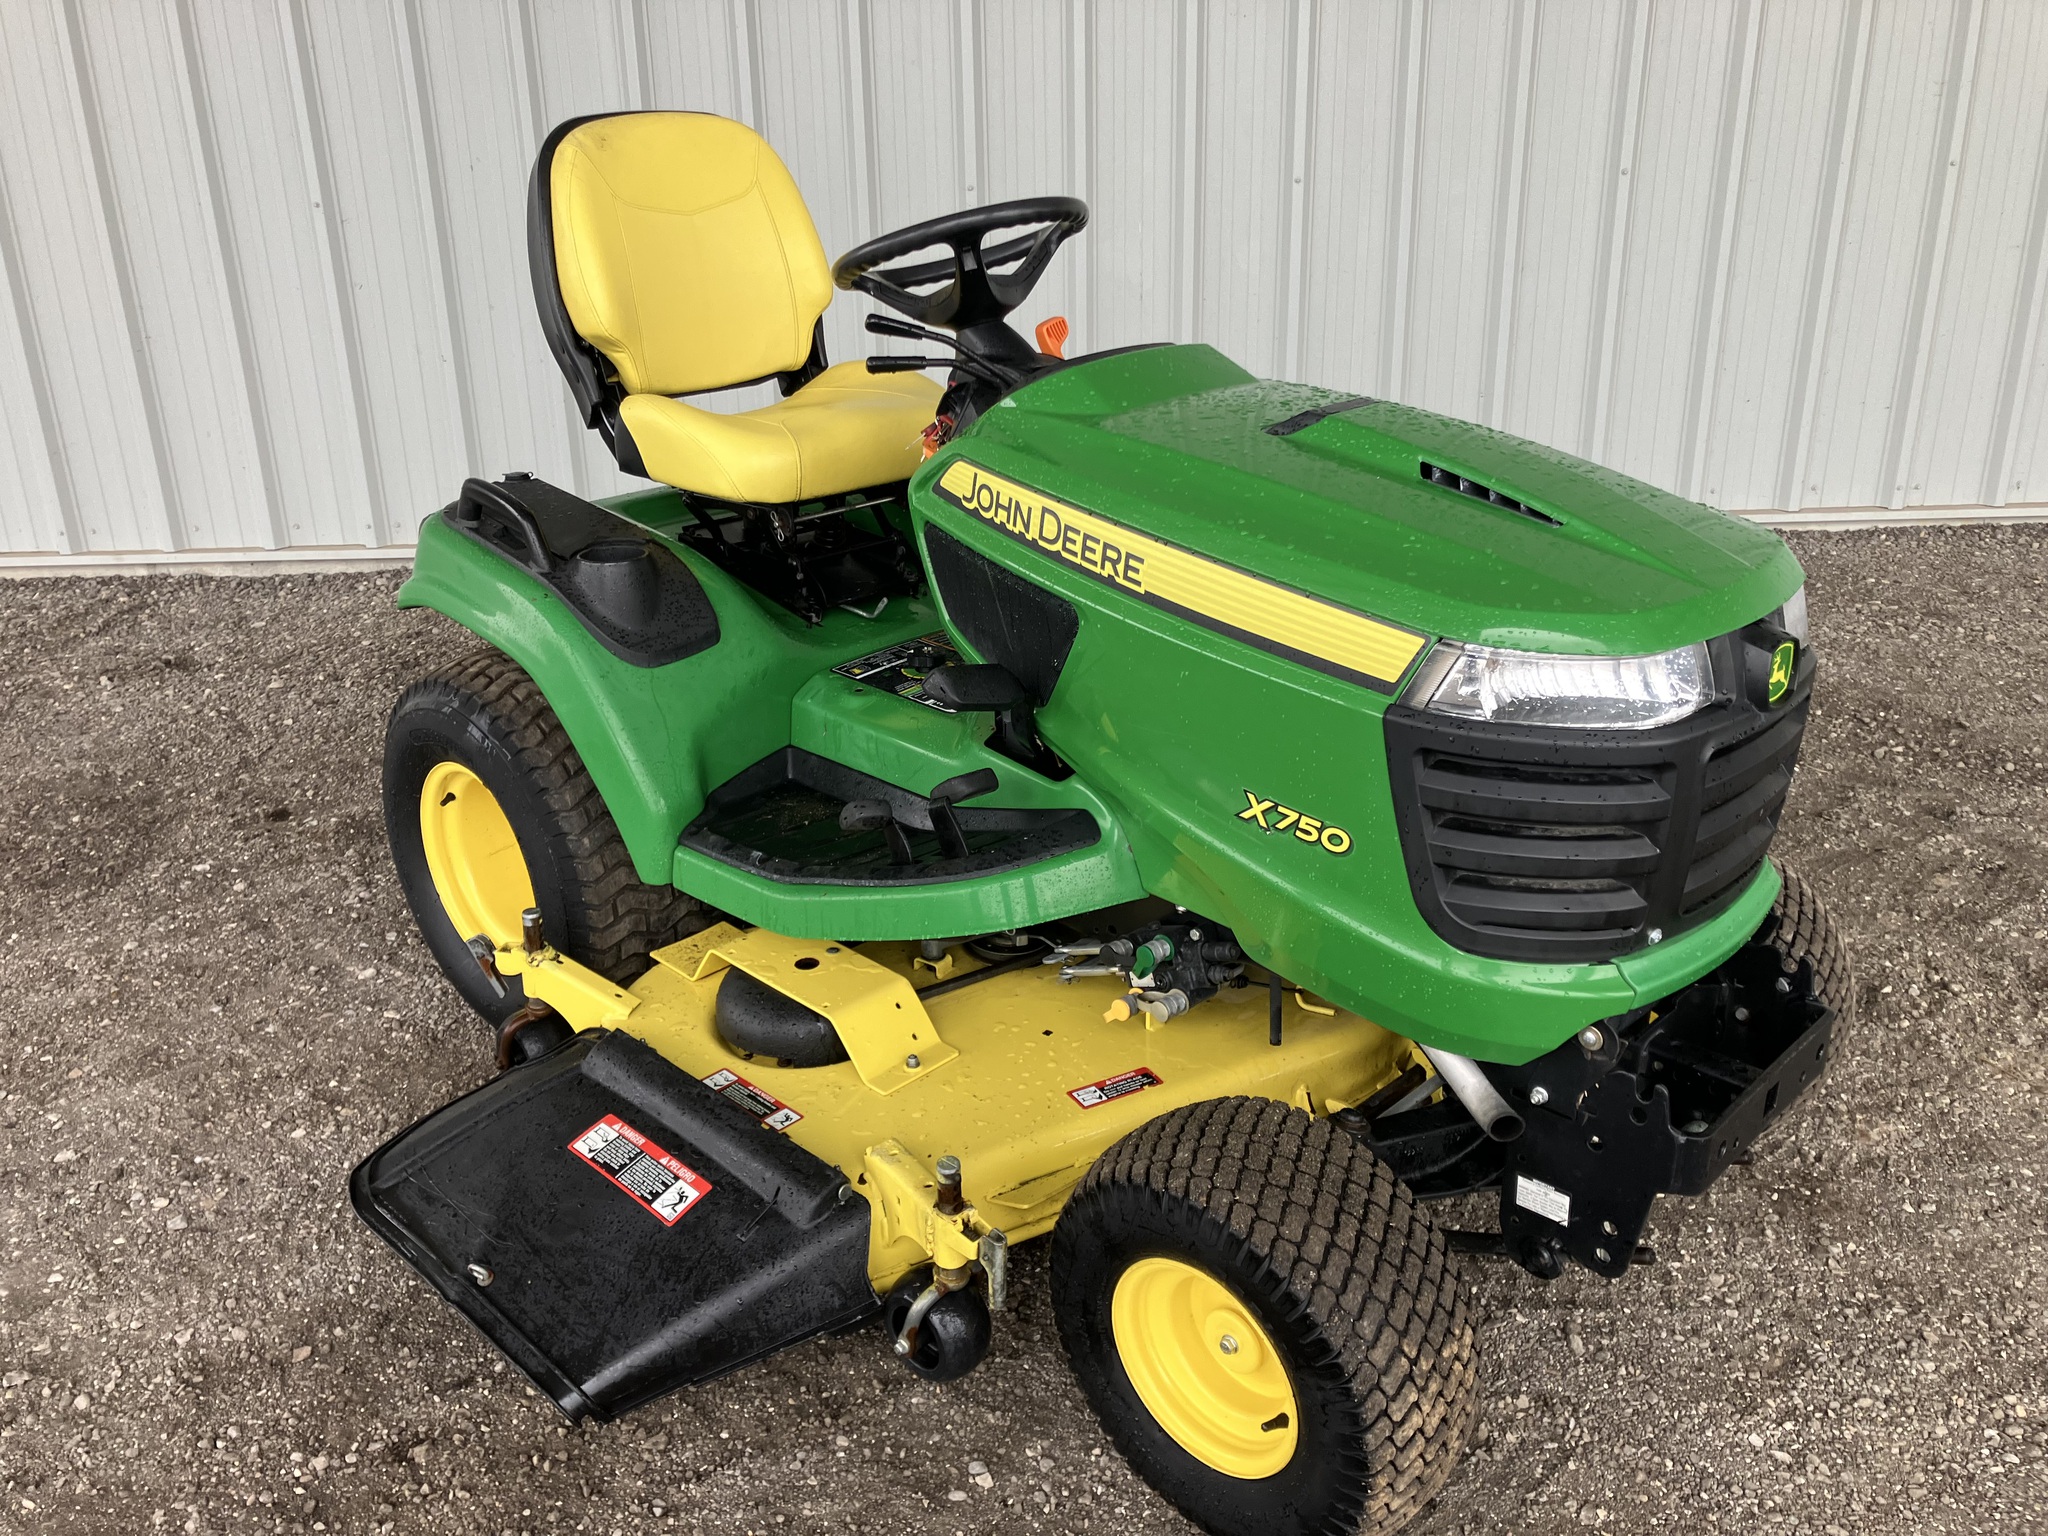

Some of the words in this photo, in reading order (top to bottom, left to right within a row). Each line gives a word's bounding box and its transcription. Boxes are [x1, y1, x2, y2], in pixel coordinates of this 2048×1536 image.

[961, 472, 1033, 538] JOHN
[1038, 505, 1145, 591] DEERE
[1235, 789, 1352, 854] X750
[1110, 1071, 1136, 1083] DANGER
[752, 1087, 776, 1103] DANGER
[619, 1125, 646, 1146] DANGER
[666, 1158, 696, 1183] PELIGRO
